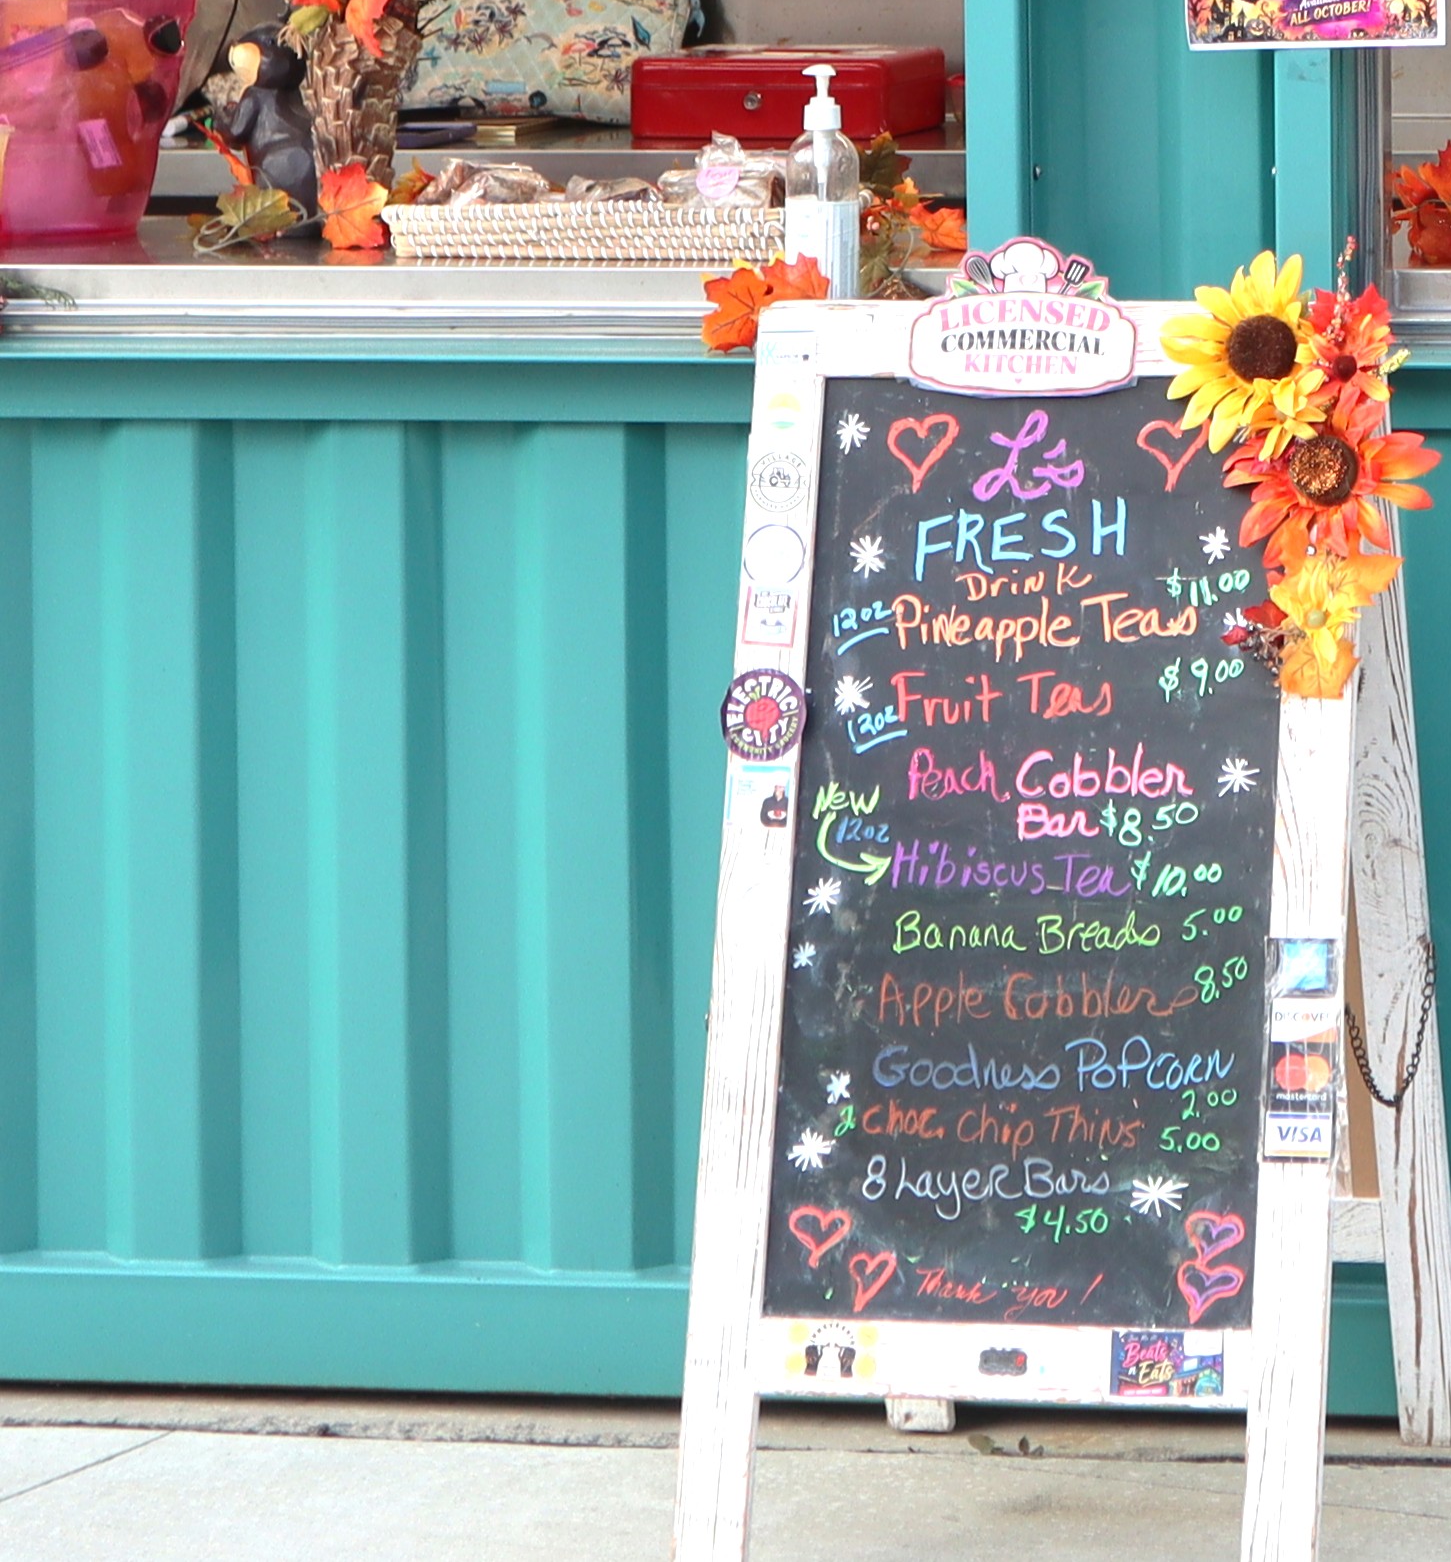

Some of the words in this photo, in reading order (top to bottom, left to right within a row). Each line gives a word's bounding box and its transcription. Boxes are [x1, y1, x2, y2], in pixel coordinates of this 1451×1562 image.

[1290, 10, 1311, 26] ALL
[940, 299, 1110, 332] LICENSED
[940, 328, 1105, 356] COMMERCIAL
[964, 354, 1078, 375] KITCHEN
[972, 409, 1085, 502] L's
[914, 496, 1128, 581] FRESH
[1165, 568, 1252, 607] $11.00
[1080, 592, 1198, 644] Teas
[726, 676, 799, 728] ELECTRIC
[890, 670, 1004, 727] Fruit
[1017, 670, 1113, 720] Teas
[1158, 657, 1245, 703] $9.00
[741, 717, 789, 747] CITY
[908, 747, 1006, 801] Peach
[1015, 742, 1194, 799] Cobbler
[1017, 802, 1100, 842] Bar
[1100, 798, 1199, 847] $8.50
[890, 839, 1045, 895] Hibiscus
[1053, 853, 1133, 897] Tea
[1131, 850, 1223, 898] $10.00
[893, 910, 1027, 954] Banana
[1036, 910, 1162, 954] Breads
[1181, 905, 1243, 942] 5.00
[877, 970, 991, 1027] Apple
[1193, 956, 1249, 1004] 8.50
[872, 1041, 1061, 1090] Goodness
[1181, 1088, 1238, 1121] 2.00
[834, 1105, 856, 1137] 2
[1159, 1126, 1221, 1153] 5.00
[1276, 1125, 1323, 1143] VISA
[861, 1153, 888, 1201] 8
[1023, 1157, 1111, 1199] Bars
[1014, 1204, 1110, 1244] $4.50
[915, 1267, 998, 1305] Thank
[1122, 1340, 1169, 1368] Beats
[1138, 1358, 1175, 1385] Eats
